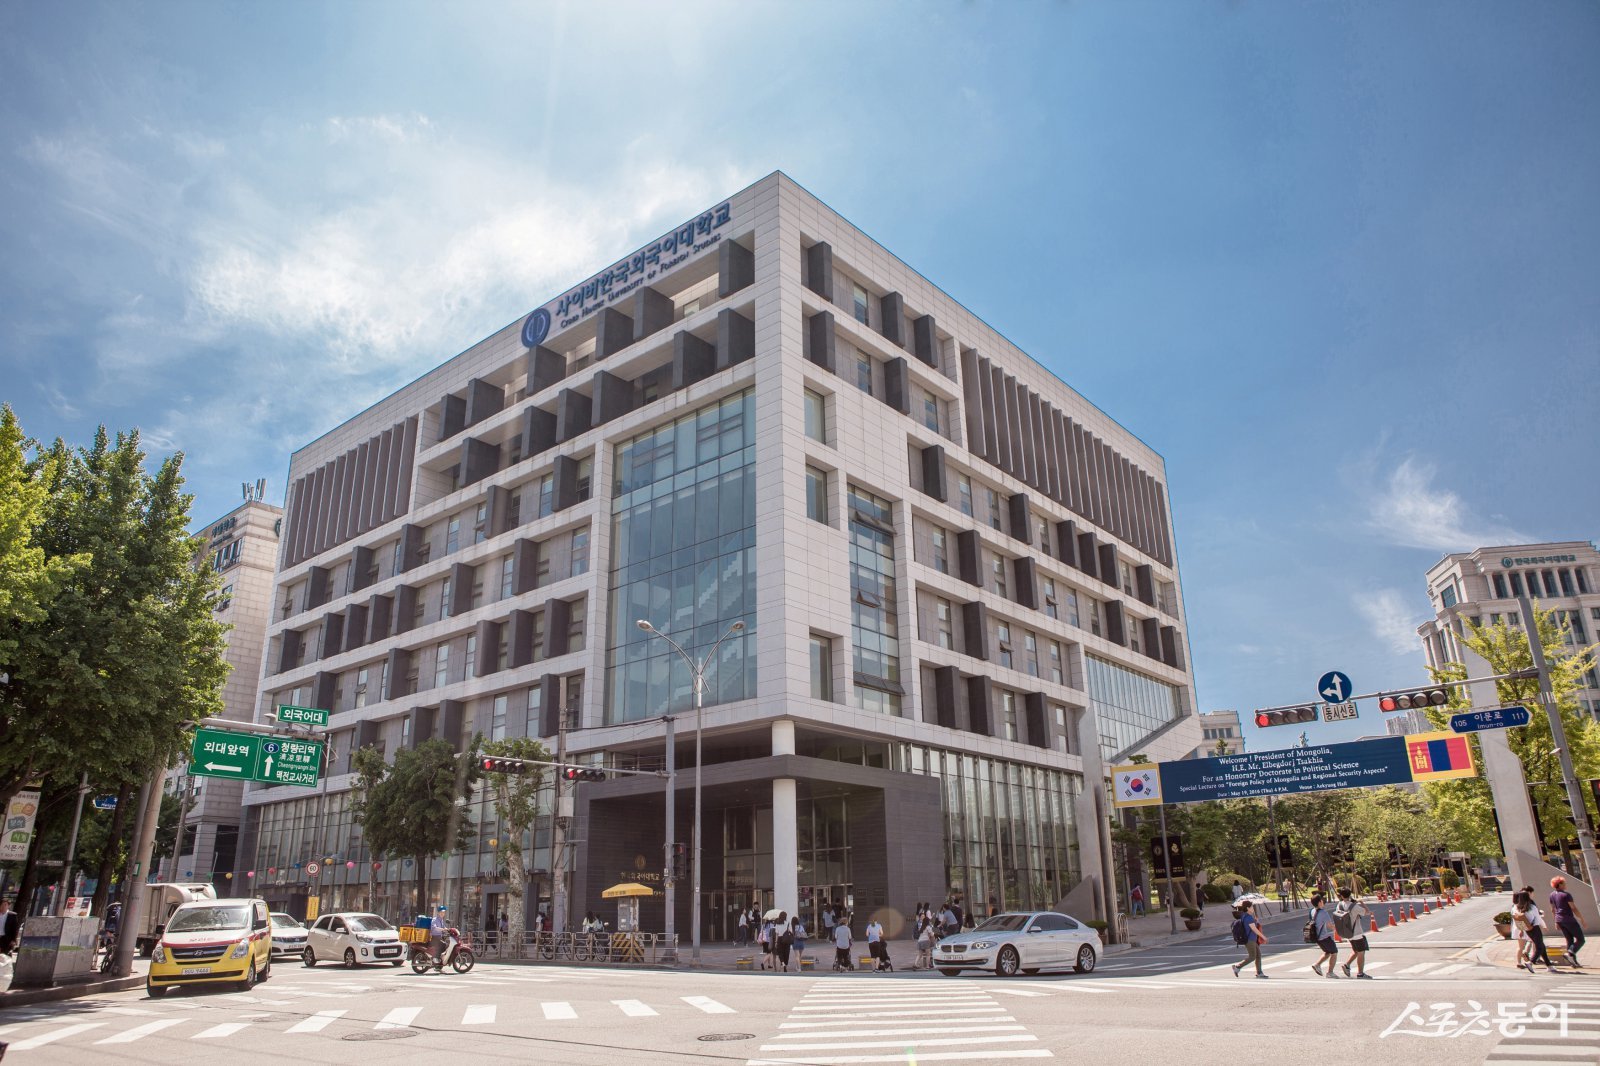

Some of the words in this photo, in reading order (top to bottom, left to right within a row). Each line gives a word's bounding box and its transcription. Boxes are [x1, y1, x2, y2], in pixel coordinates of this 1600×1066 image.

[556, 202, 731, 317] 사이버한국외국어대학교
[283, 709, 323, 723] 외국어대
[1325, 704, 1356, 720] 동시신호
[1474, 711, 1503, 721] 이문로
[1512, 712, 1525, 720] 111
[203, 741, 249, 757] 외대앞역
[268, 743, 275, 752] 6
[281, 742, 316, 756] 청량리역
[1219, 757, 1248, 765] Welcome
[1254, 751, 1286, 761] President
[1286, 750, 1294, 758] of
[1296, 747, 1333, 757] Mongolia,
[1296, 756, 1324, 766] Tsakhia
[1179, 784, 1198, 792] Special
[1273, 776, 1300, 784] Mongolia
[1312, 771, 1337, 780] Regional
[1338, 768, 1361, 777] Security
[1202, 775, 1214, 783] For
[1224, 771, 1257, 781] Honorary
[1258, 768, 1292, 777] Doctorate
[1293, 766, 1301, 774] in
[1302, 763, 1331, 773] Political
[1332, 761, 1360, 770] Science
